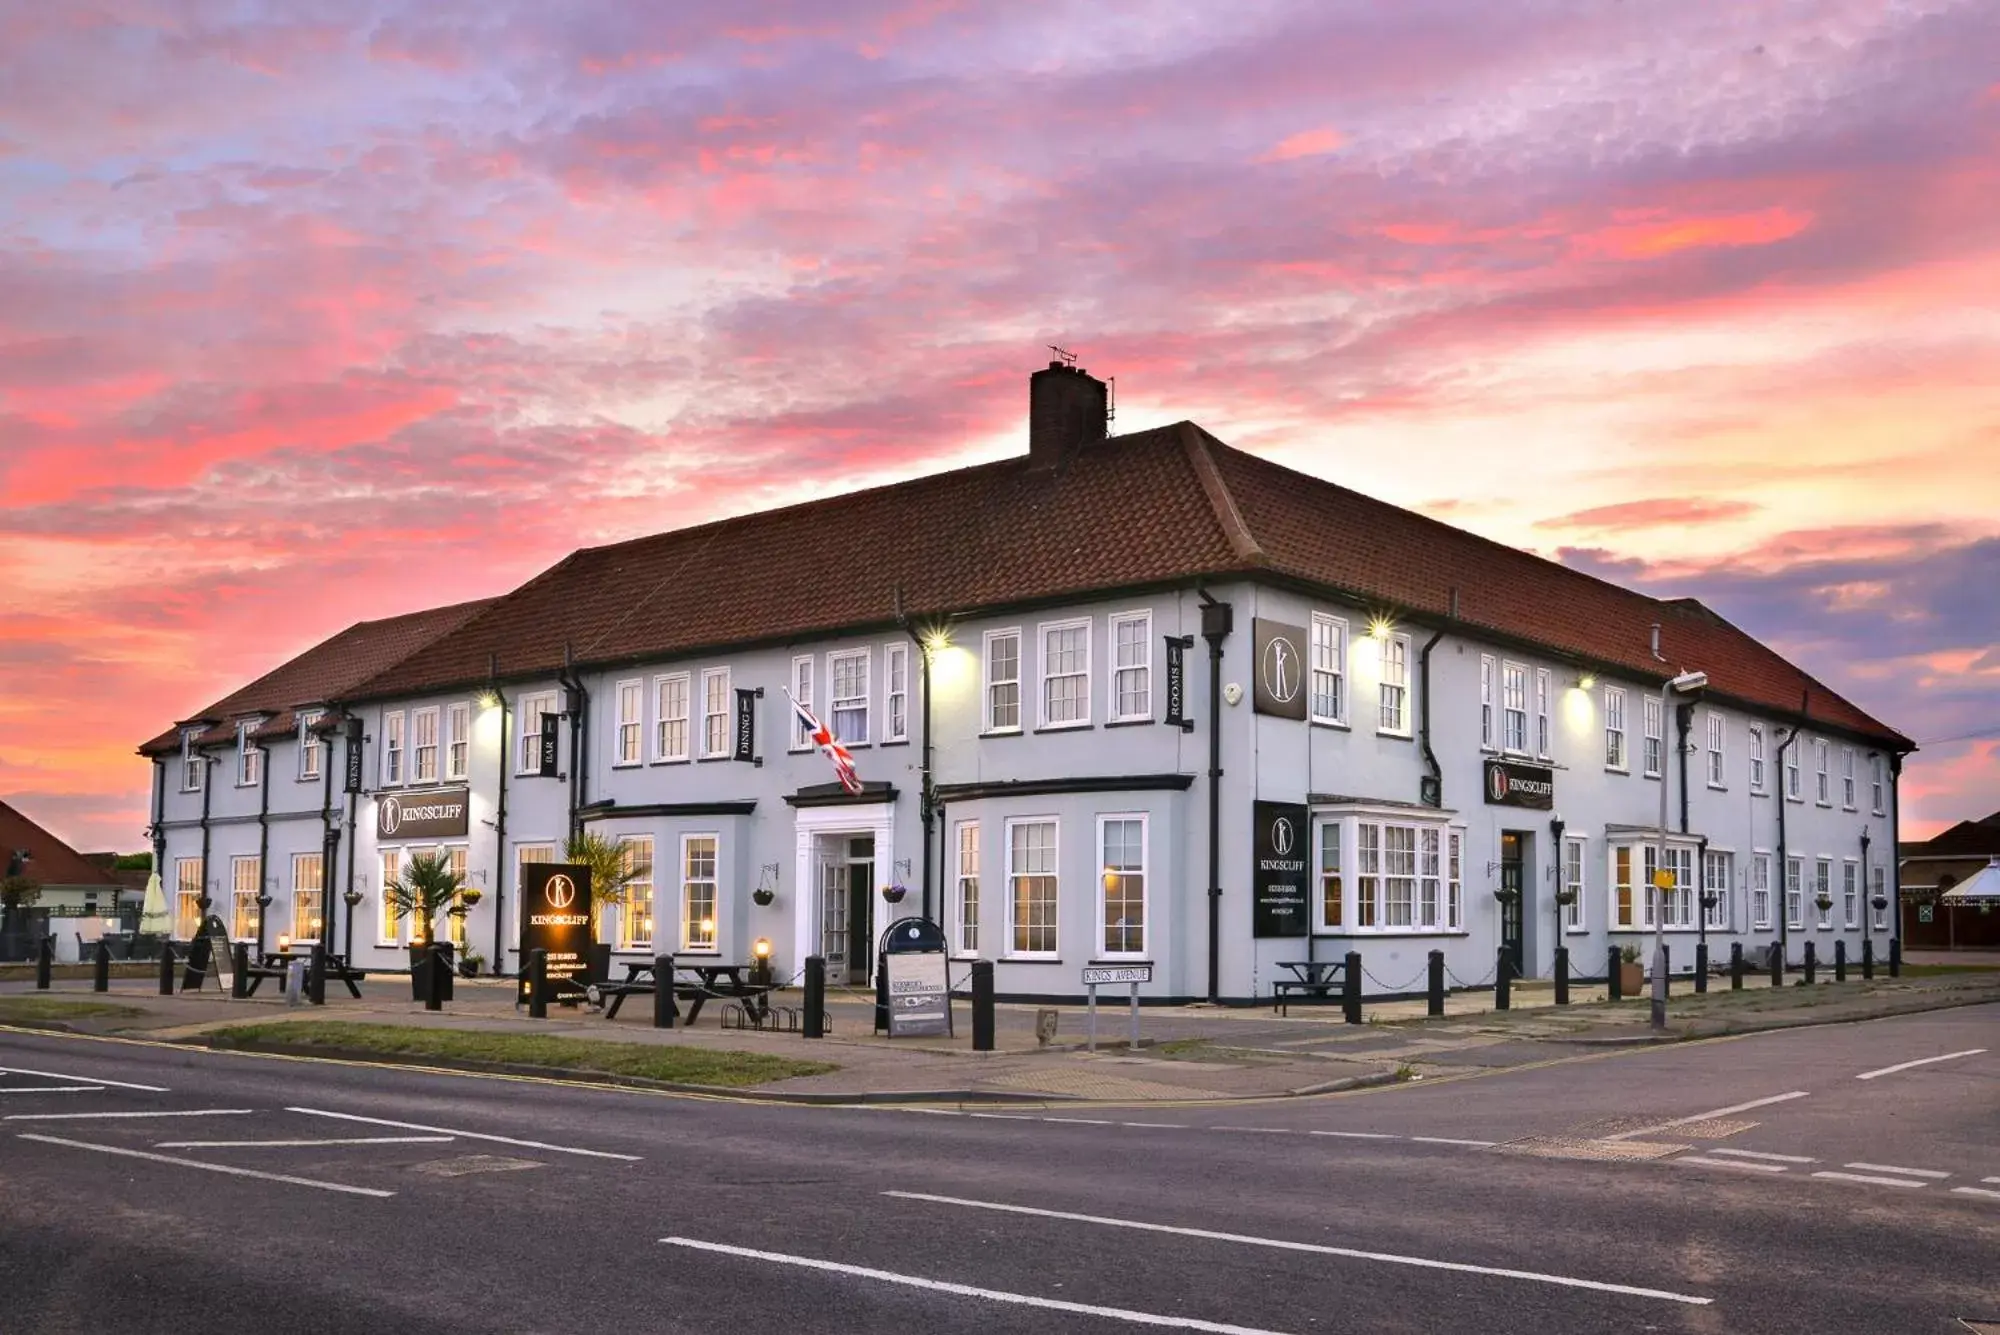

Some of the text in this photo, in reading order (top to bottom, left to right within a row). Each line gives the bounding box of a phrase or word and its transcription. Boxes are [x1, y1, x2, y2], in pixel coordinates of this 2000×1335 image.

[1171, 666, 1180, 716] ROOMS
[740, 714, 750, 754] DINING
[545, 741, 553, 763] BAR
[350, 755, 359, 788] EVENTS
[1509, 778, 1552, 795] KINGSCLIFF
[402, 804, 462, 821] KINGSCLIFF
[1260, 859, 1304, 871] KINGSCLIFF
[1086, 969, 1147, 982] KINGS AVENUE
